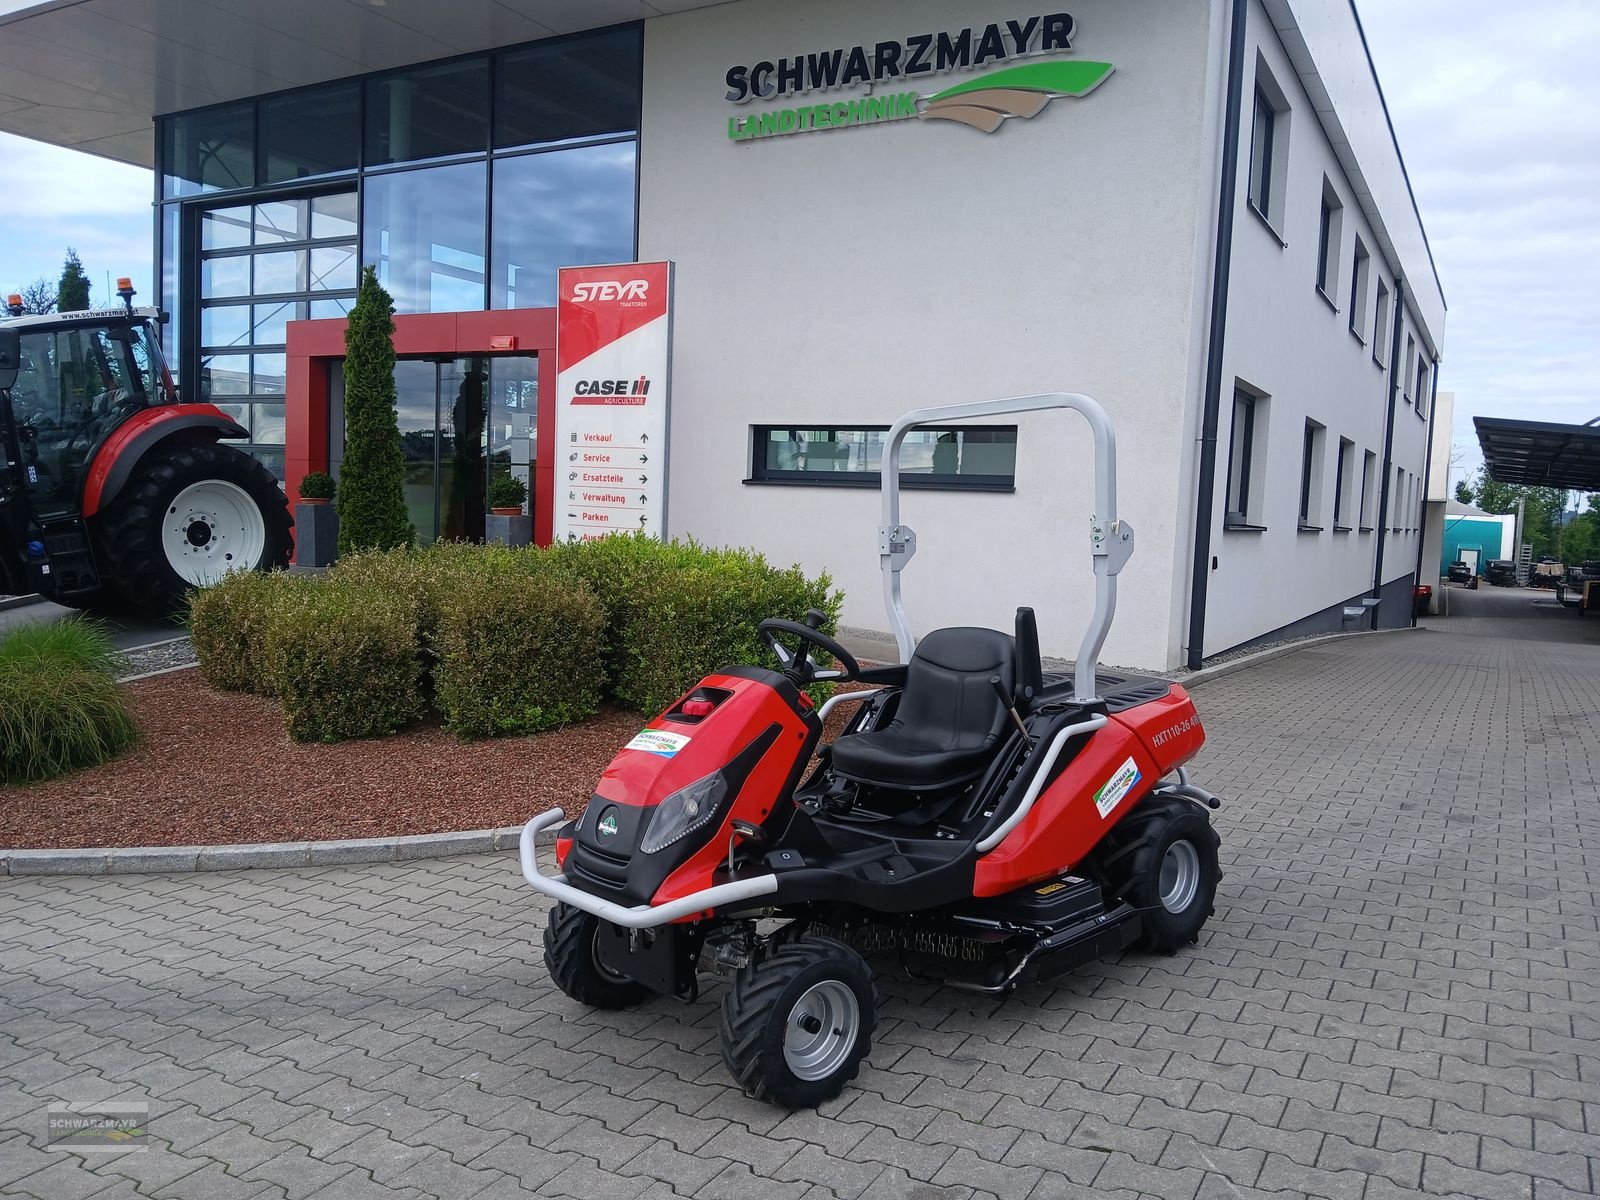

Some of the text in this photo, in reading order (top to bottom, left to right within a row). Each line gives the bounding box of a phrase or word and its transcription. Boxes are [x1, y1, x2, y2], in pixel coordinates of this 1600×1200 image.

[725, 12, 1076, 103] SCHWARZMAYR
[728, 91, 919, 140] LANDTECHNIK
[570, 279, 649, 303] STEYR
[61, 308, 140, 321] www.schwarzmayat
[574, 380, 628, 395] CASE
[603, 397, 645, 405] AGRICULTURE
[583, 433, 612, 442] Verkauf
[583, 453, 611, 463] Service
[582, 473, 624, 483] Ersatzteile
[582, 492, 626, 504] Verwaltung
[582, 512, 609, 522] Parken
[1151, 719, 1191, 748] HXT110-26
[1099, 767, 1132, 804] SCHWARZMAYR
